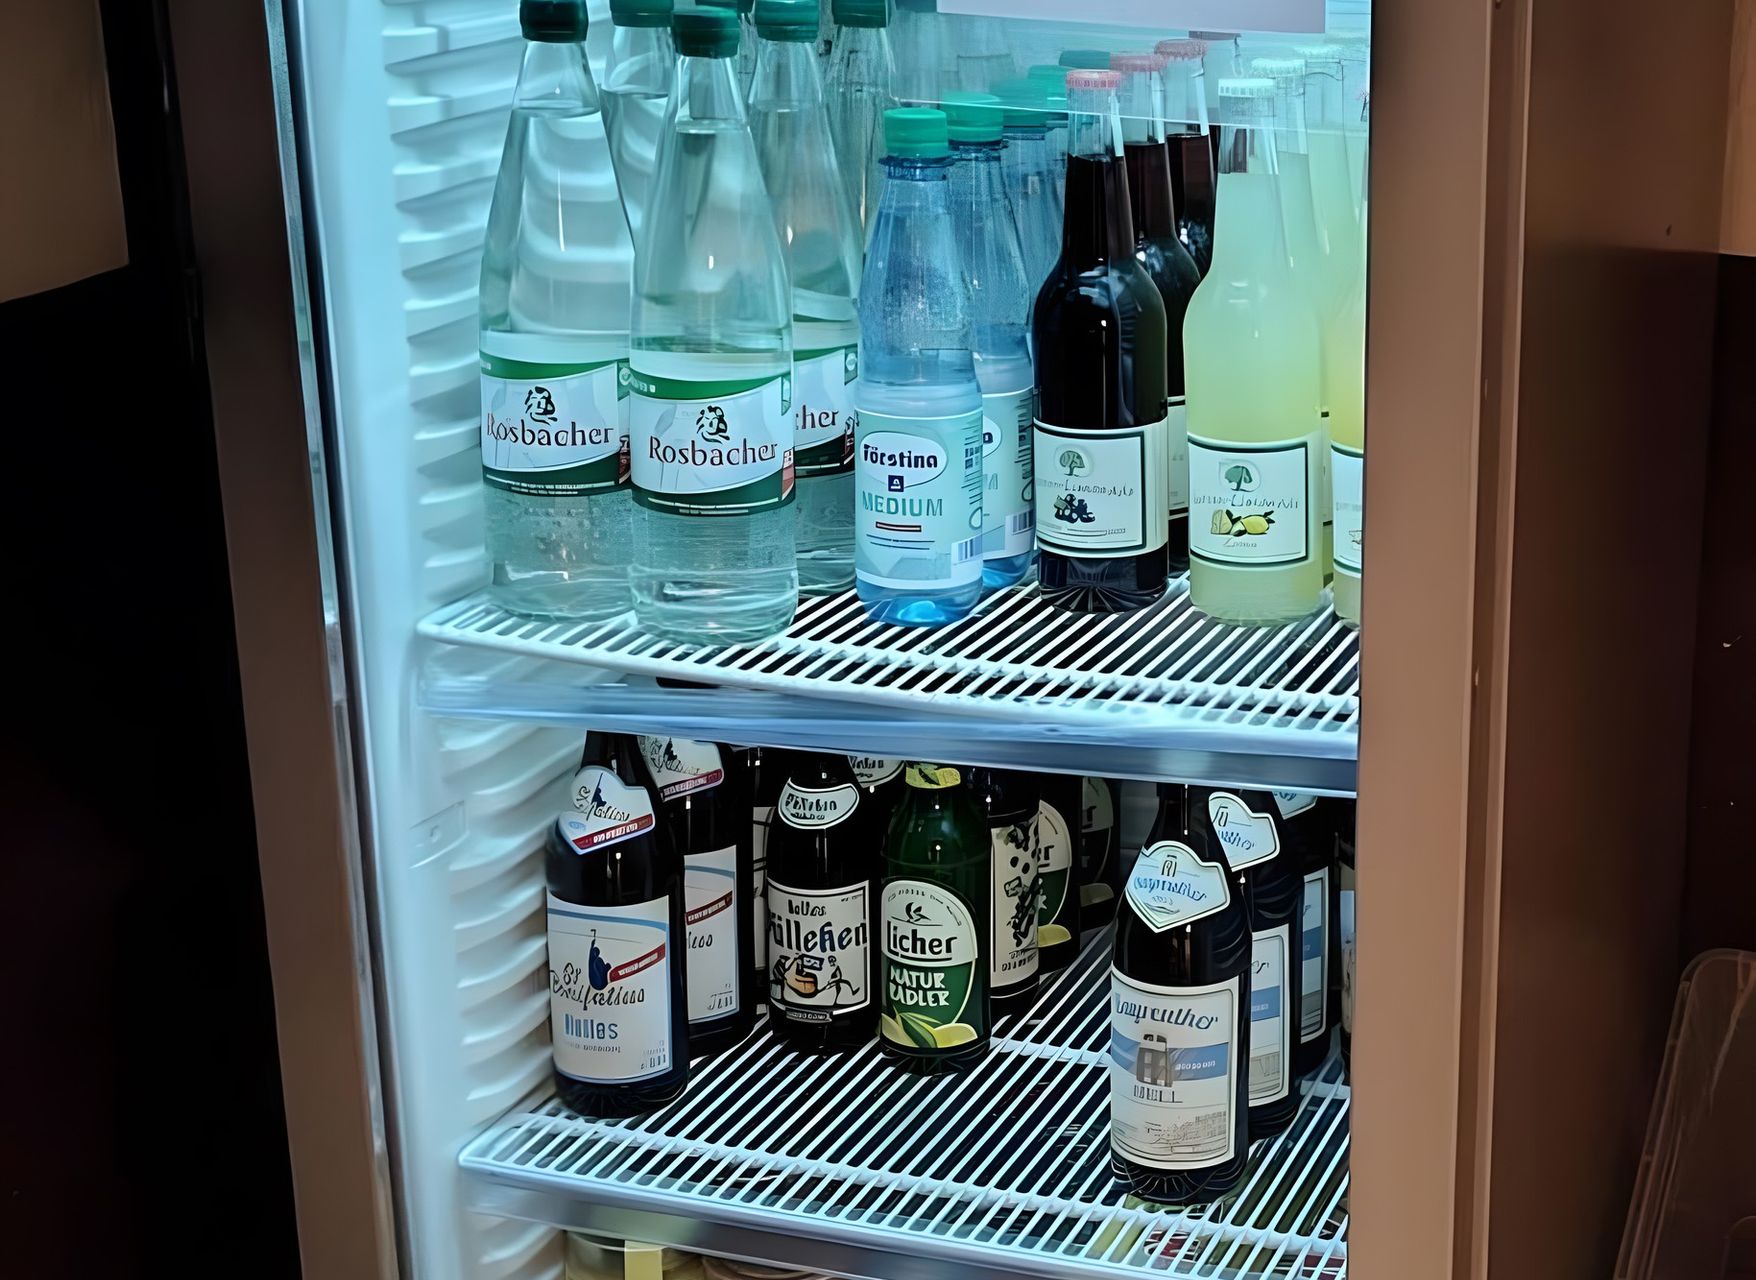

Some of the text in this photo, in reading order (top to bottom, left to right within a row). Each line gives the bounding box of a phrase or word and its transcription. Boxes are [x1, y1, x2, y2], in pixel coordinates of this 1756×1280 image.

[486, 412, 615, 447] Rosbacher
[649, 436, 779, 467] Rosbacher
[862, 490, 944, 517] MEDIUM
[886, 921, 958, 956] Licher
[889, 965, 946, 990] NATUR
